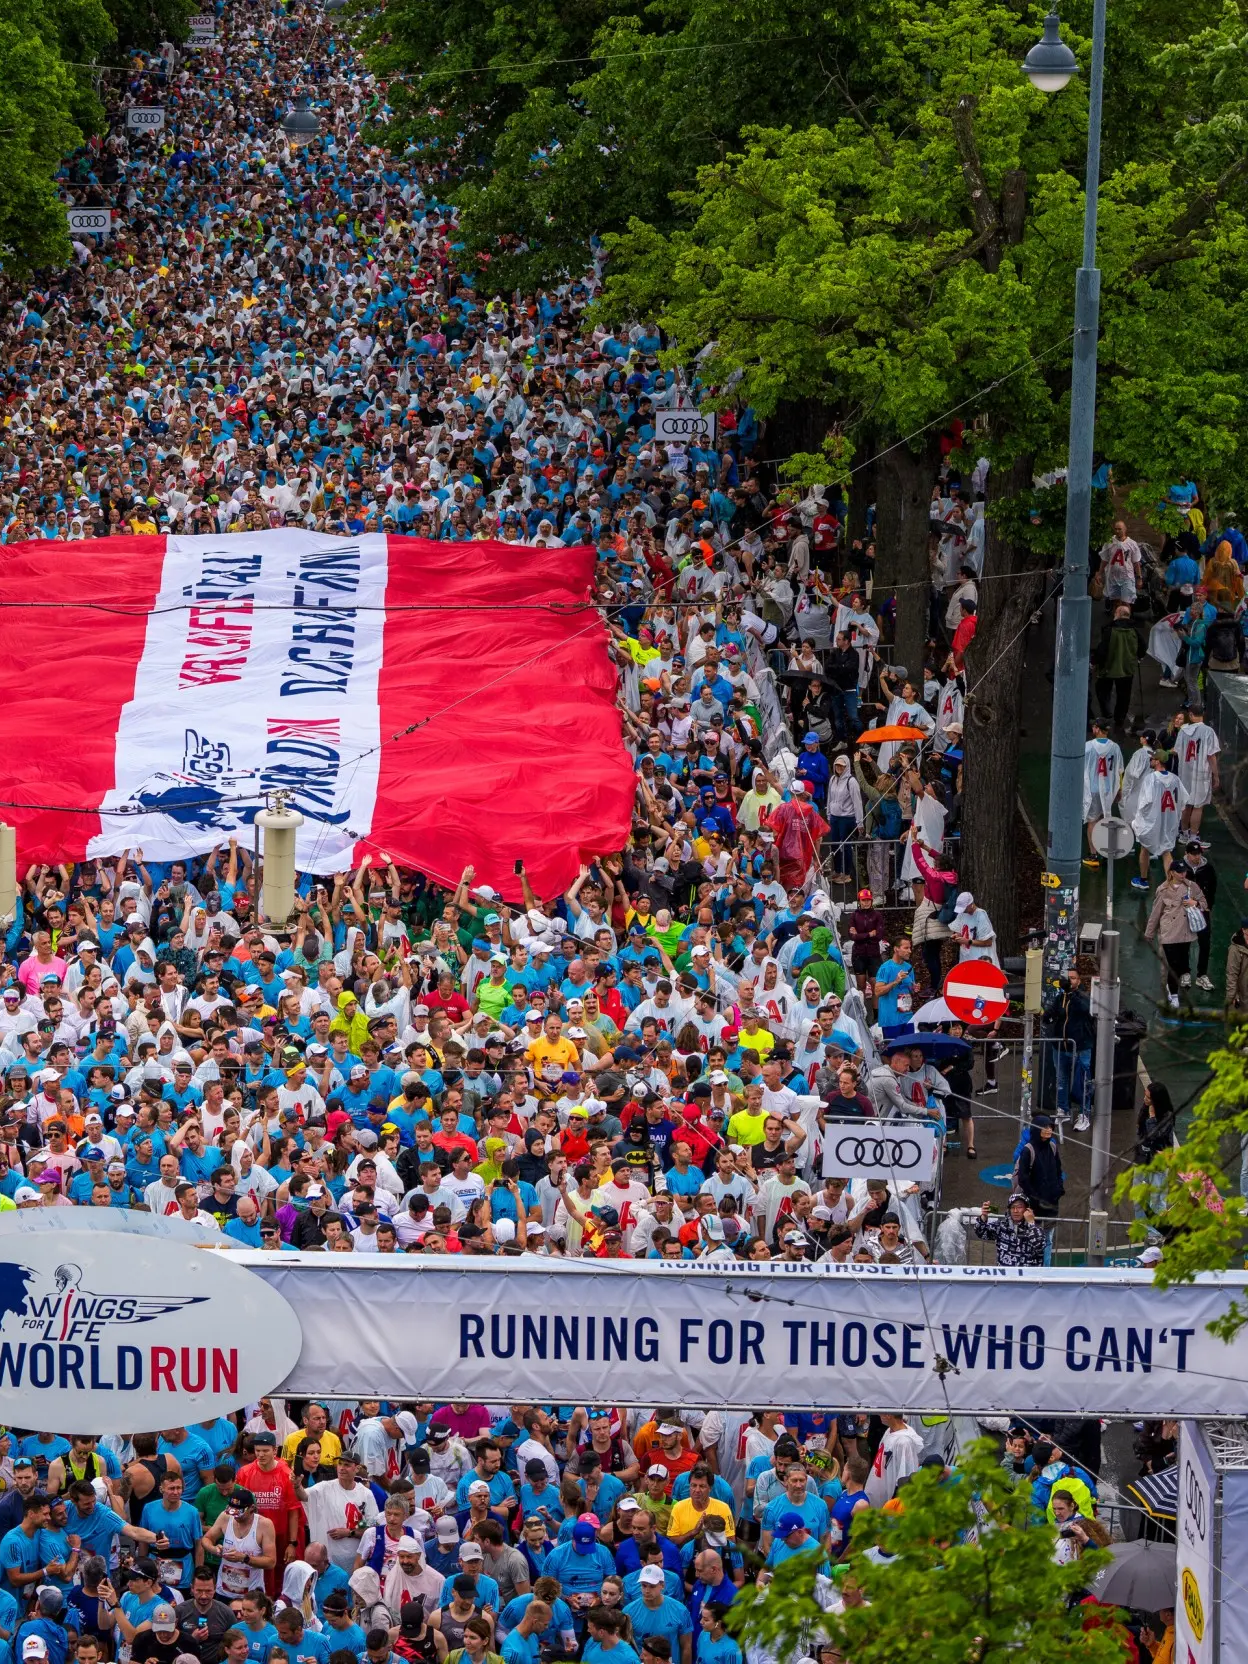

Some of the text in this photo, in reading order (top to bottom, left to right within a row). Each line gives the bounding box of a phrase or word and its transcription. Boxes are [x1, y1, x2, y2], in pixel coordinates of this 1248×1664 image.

[22, 1319, 45, 1329] FOR
[460, 1314, 659, 1362] RUNNING
[679, 1318, 765, 1365] FOR
[782, 1321, 925, 1369] THOSE
[942, 1324, 1045, 1370] WHO
[151, 1346, 238, 1393] RUN
